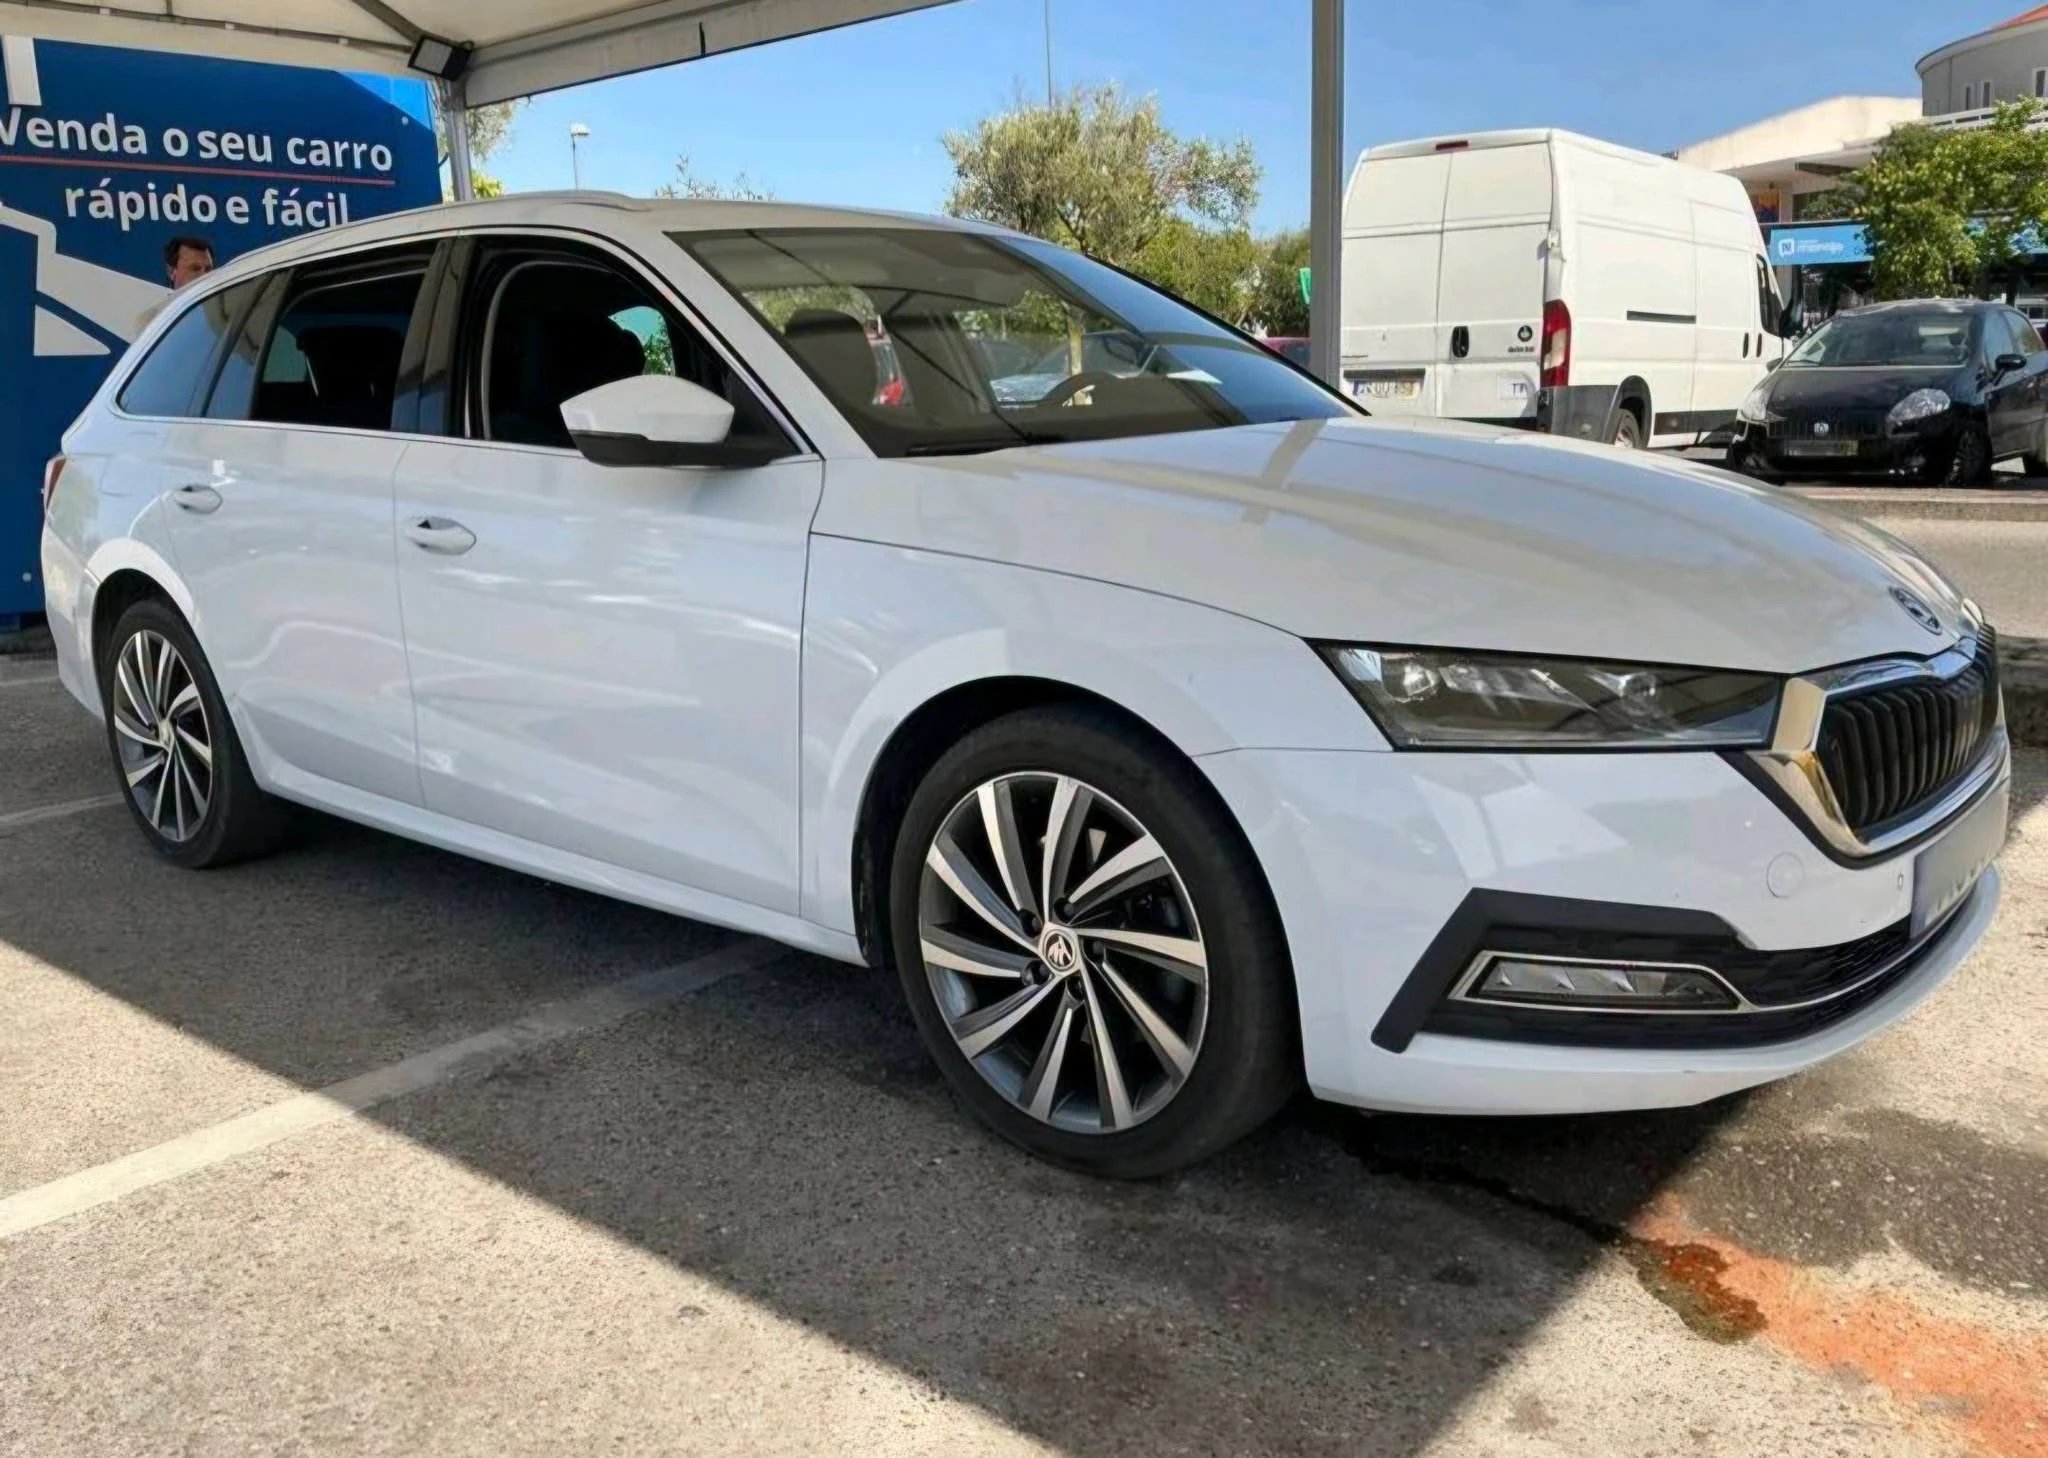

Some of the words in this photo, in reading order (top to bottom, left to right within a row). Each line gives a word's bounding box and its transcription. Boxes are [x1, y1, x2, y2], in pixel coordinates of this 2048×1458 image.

[0, 107, 148, 155] Venda
[163, 127, 189, 157] o
[197, 130, 273, 163] seu
[286, 137, 393, 171] carro
[65, 177, 217, 232] rápido
[225, 195, 249, 224] e
[262, 187, 349, 229] fácil
